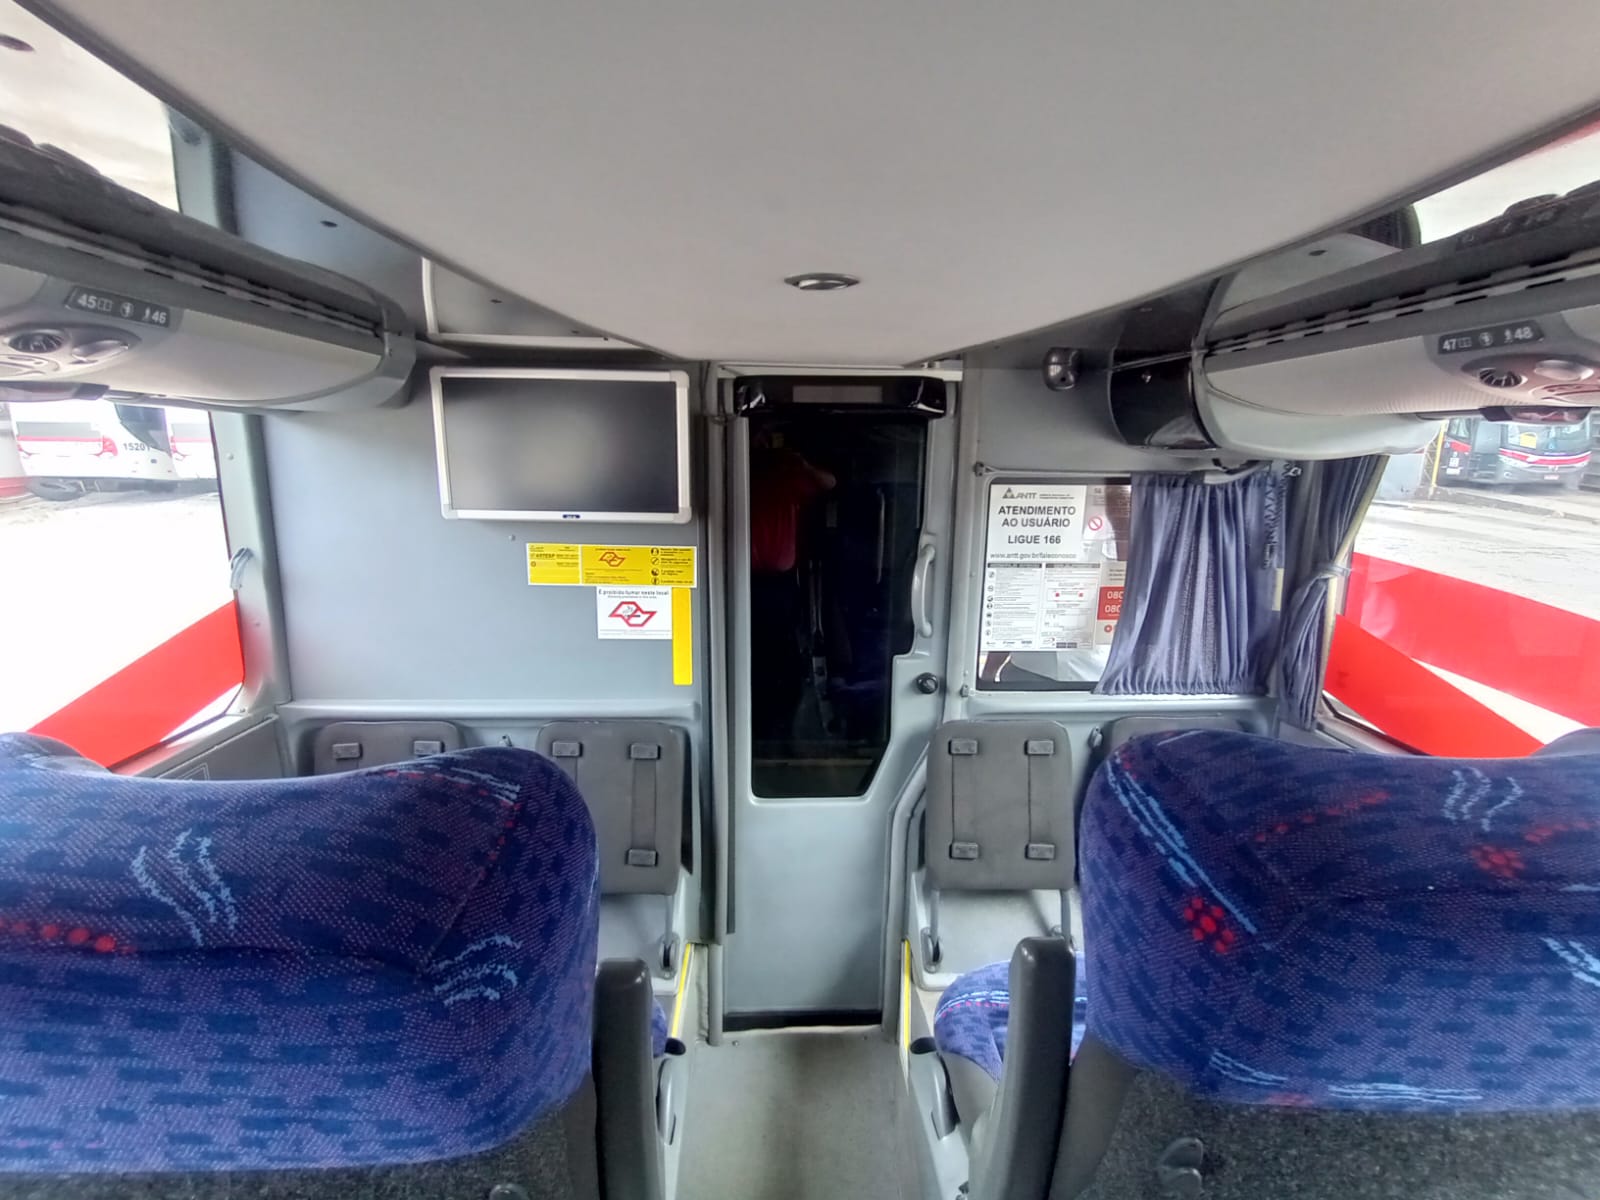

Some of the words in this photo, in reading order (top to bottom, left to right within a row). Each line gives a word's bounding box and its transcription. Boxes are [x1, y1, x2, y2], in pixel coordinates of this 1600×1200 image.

[77, 293, 97, 309] 45
[151, 310, 167, 324] 46
[1514, 326, 1533, 340] 48
[1442, 338, 1457, 351] 47
[998, 506, 1076, 515] ATENDIMENTO
[1001, 518, 1019, 527] AO
[1021, 516, 1070, 527] USUÁRIO
[1008, 535, 1040, 544] LIGUE
[1043, 535, 1061, 544] 166
